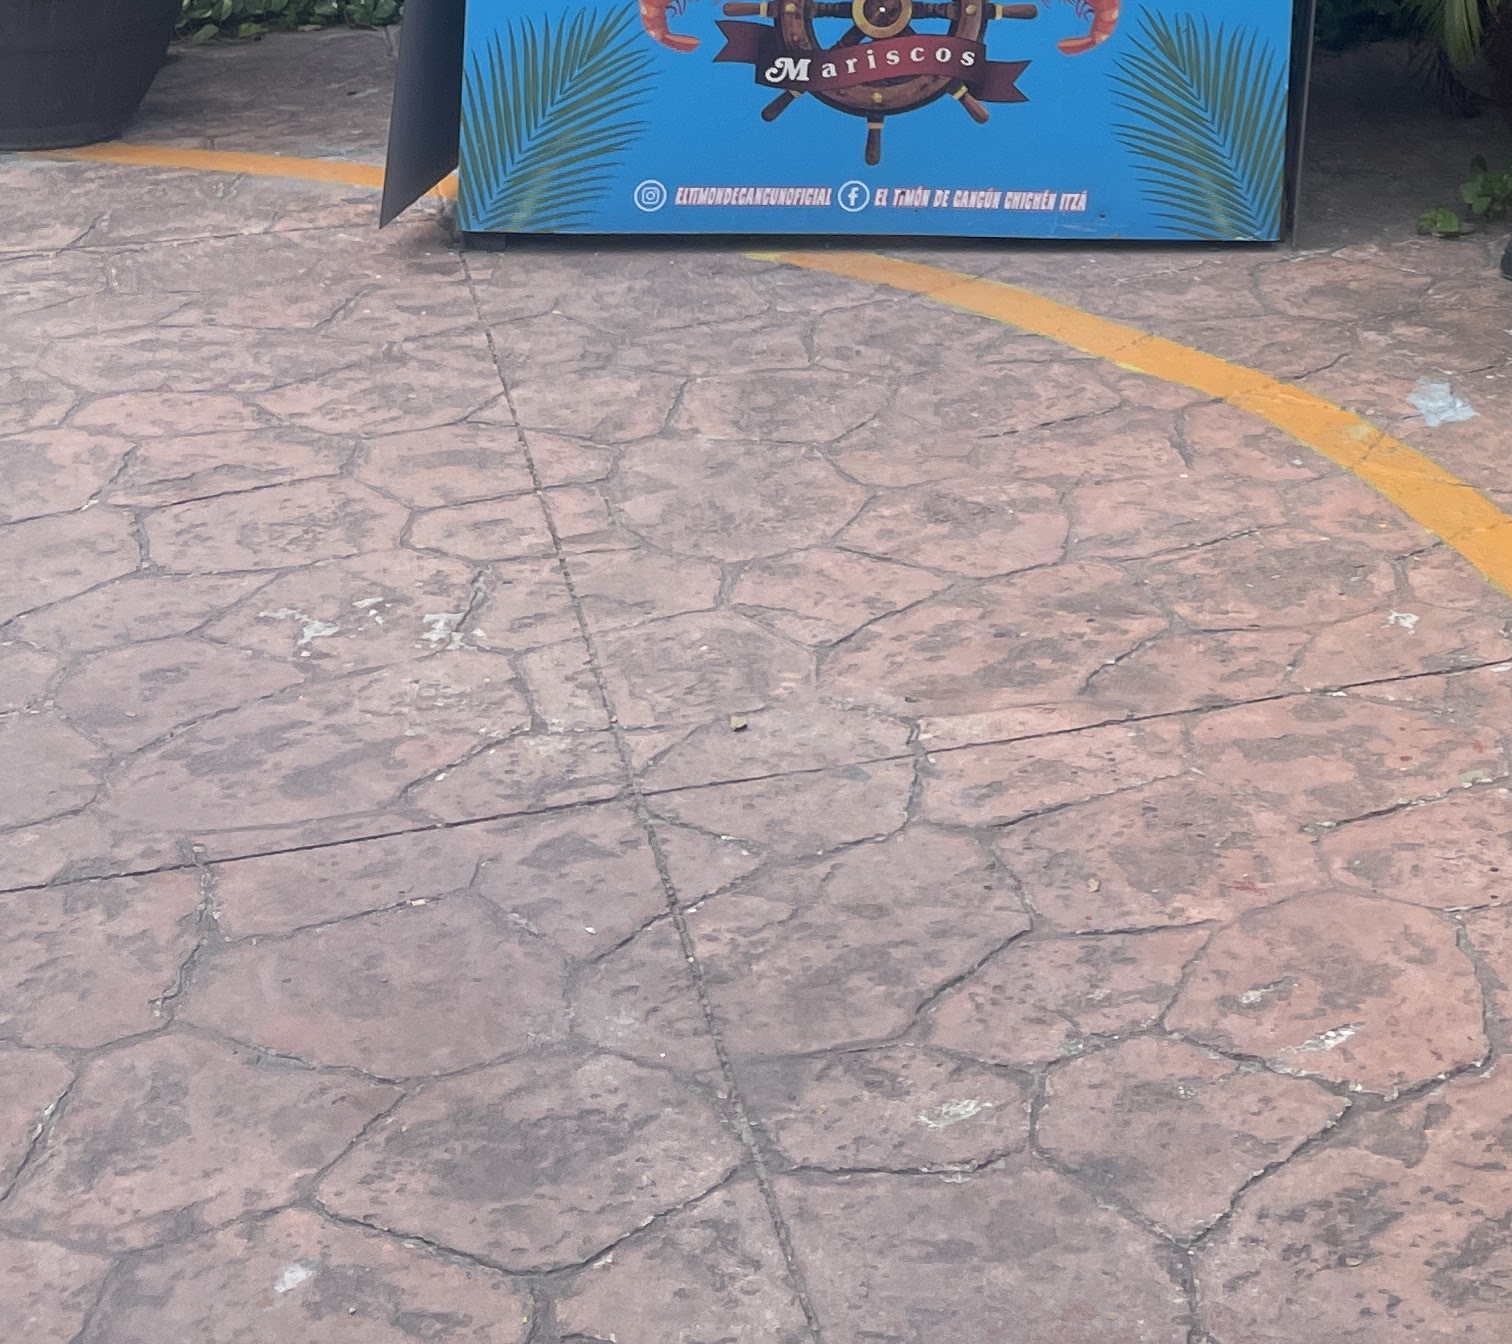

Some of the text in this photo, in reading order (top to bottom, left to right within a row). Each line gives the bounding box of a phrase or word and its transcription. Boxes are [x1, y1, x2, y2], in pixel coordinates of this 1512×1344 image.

[766, 47, 975, 83] Mariscos
[874, 185, 1088, 212] EL TIMÓN DE CANCÚN CHICHÉN ITZÁ
